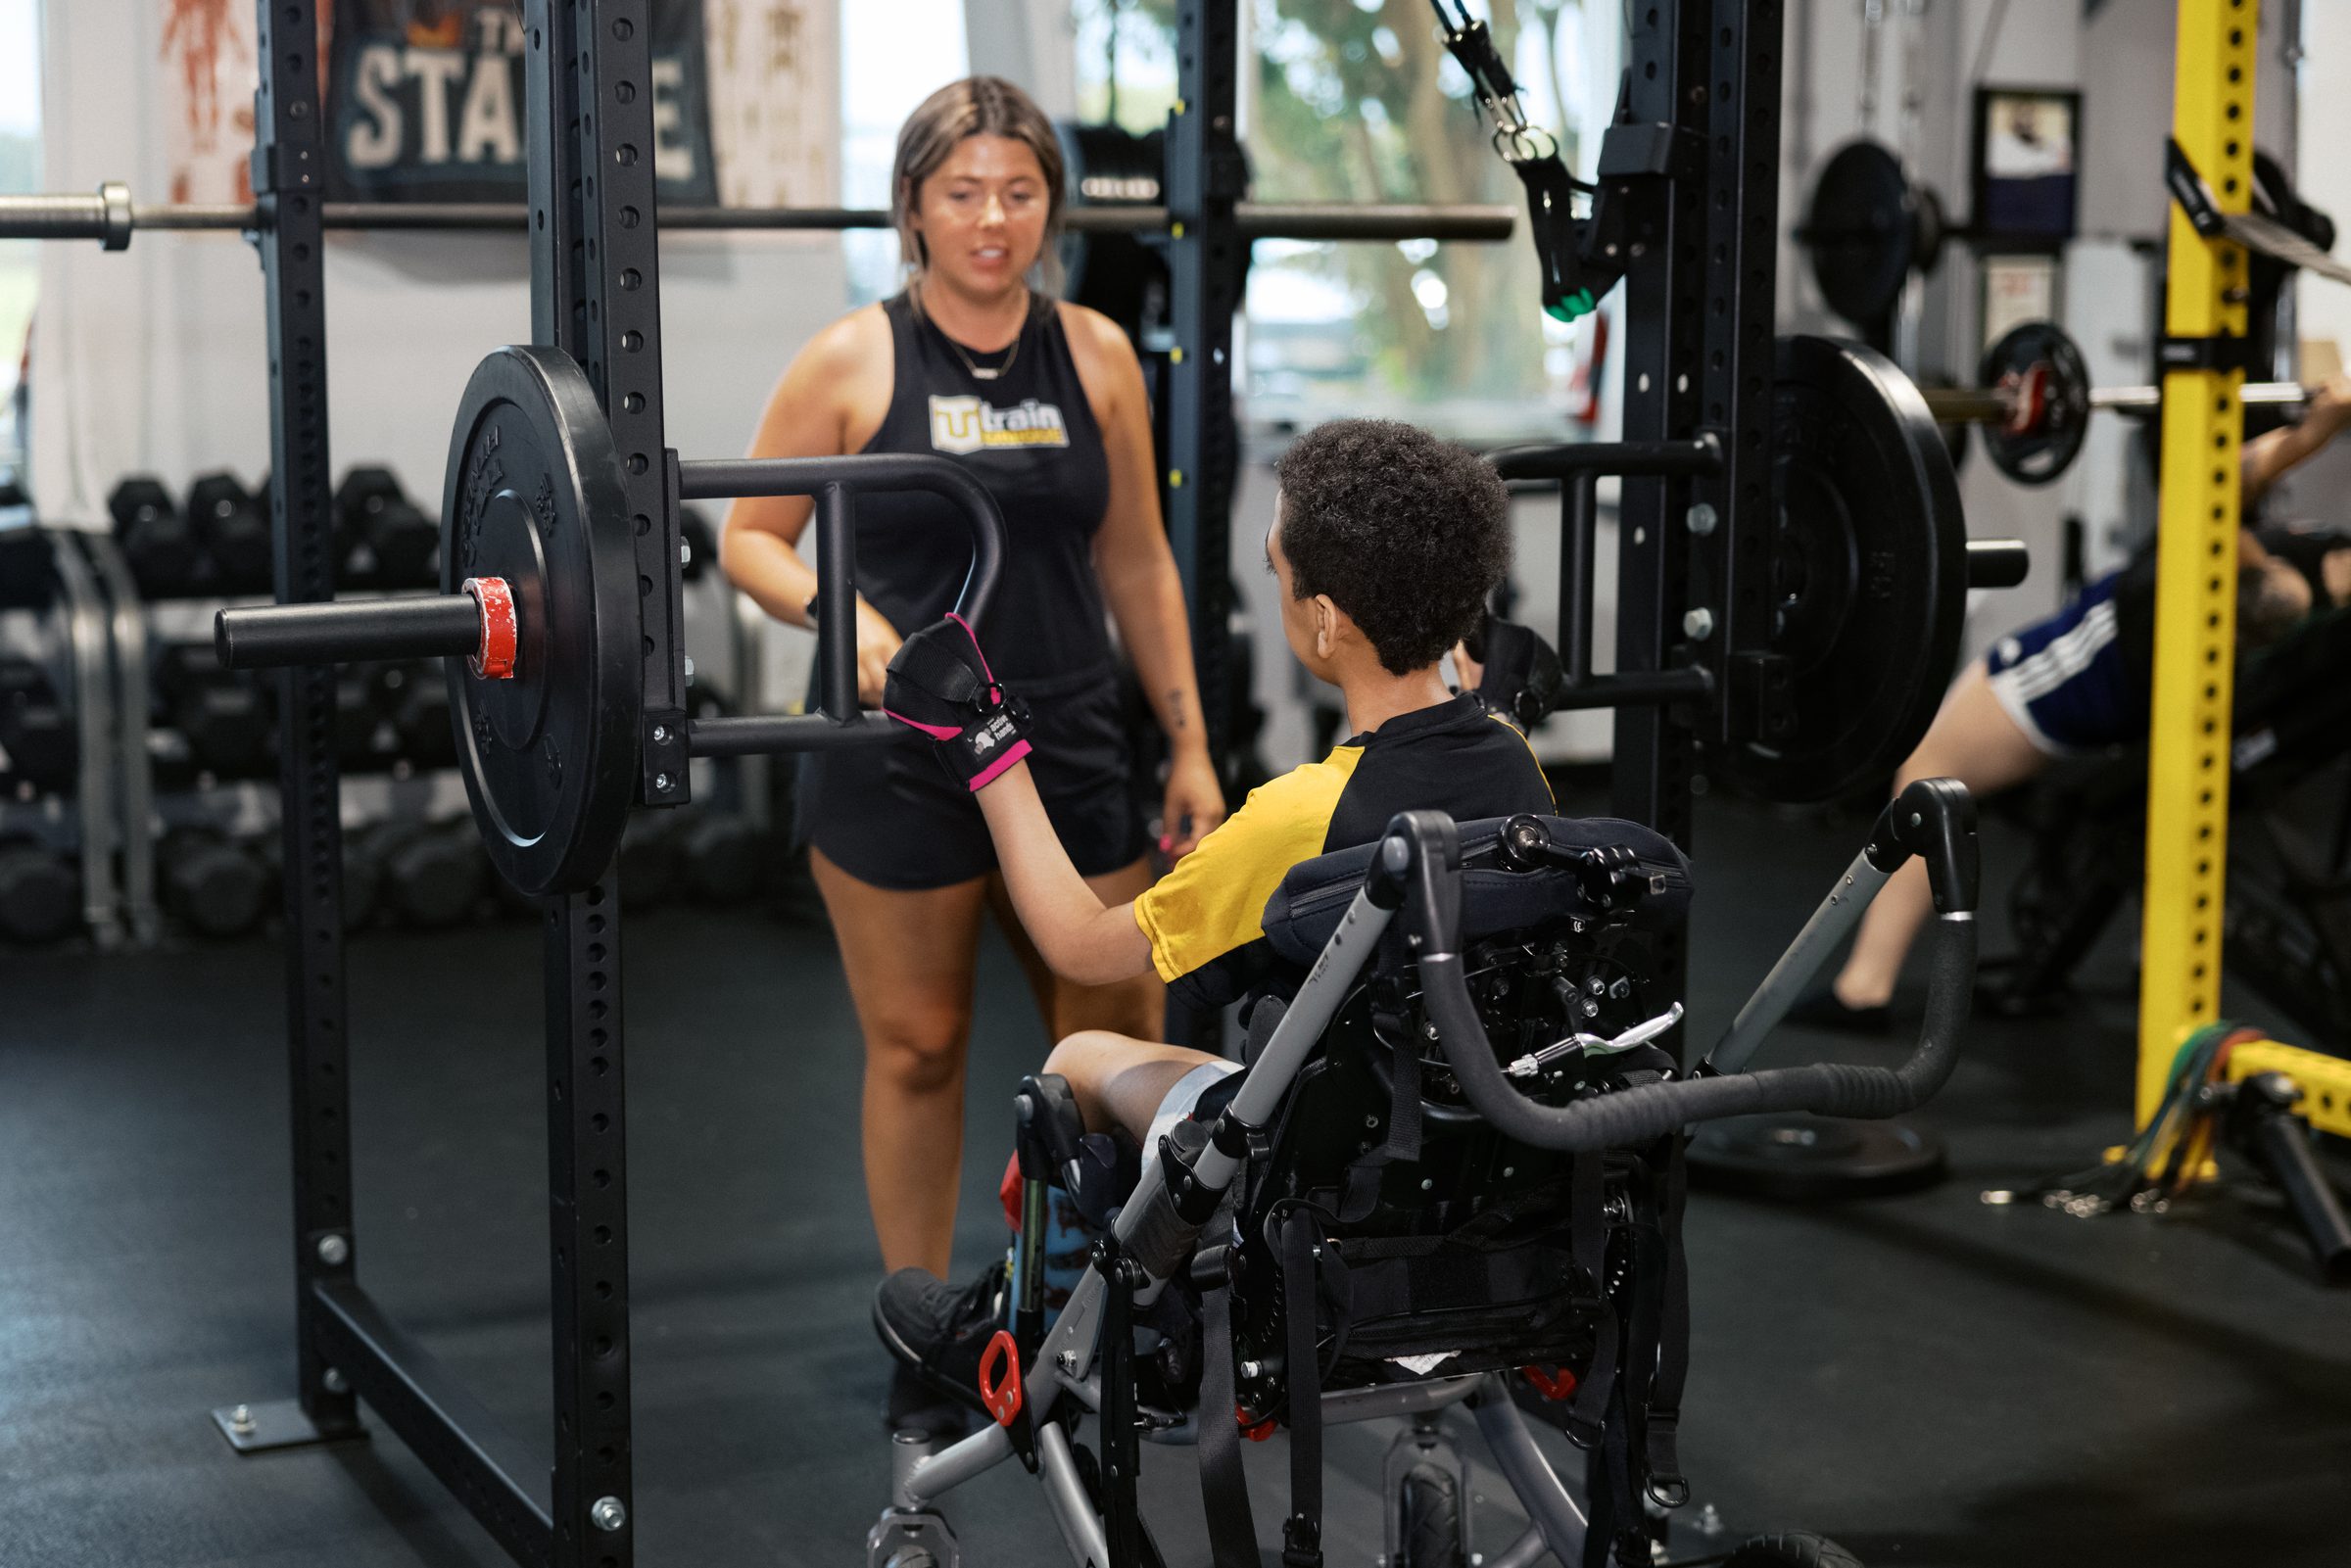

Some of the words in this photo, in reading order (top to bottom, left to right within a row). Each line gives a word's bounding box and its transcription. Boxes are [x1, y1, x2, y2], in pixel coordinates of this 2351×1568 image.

[348, 46, 695, 179] STAE
[989, 714, 1008, 732] active
[994, 723, 1014, 740] hands
